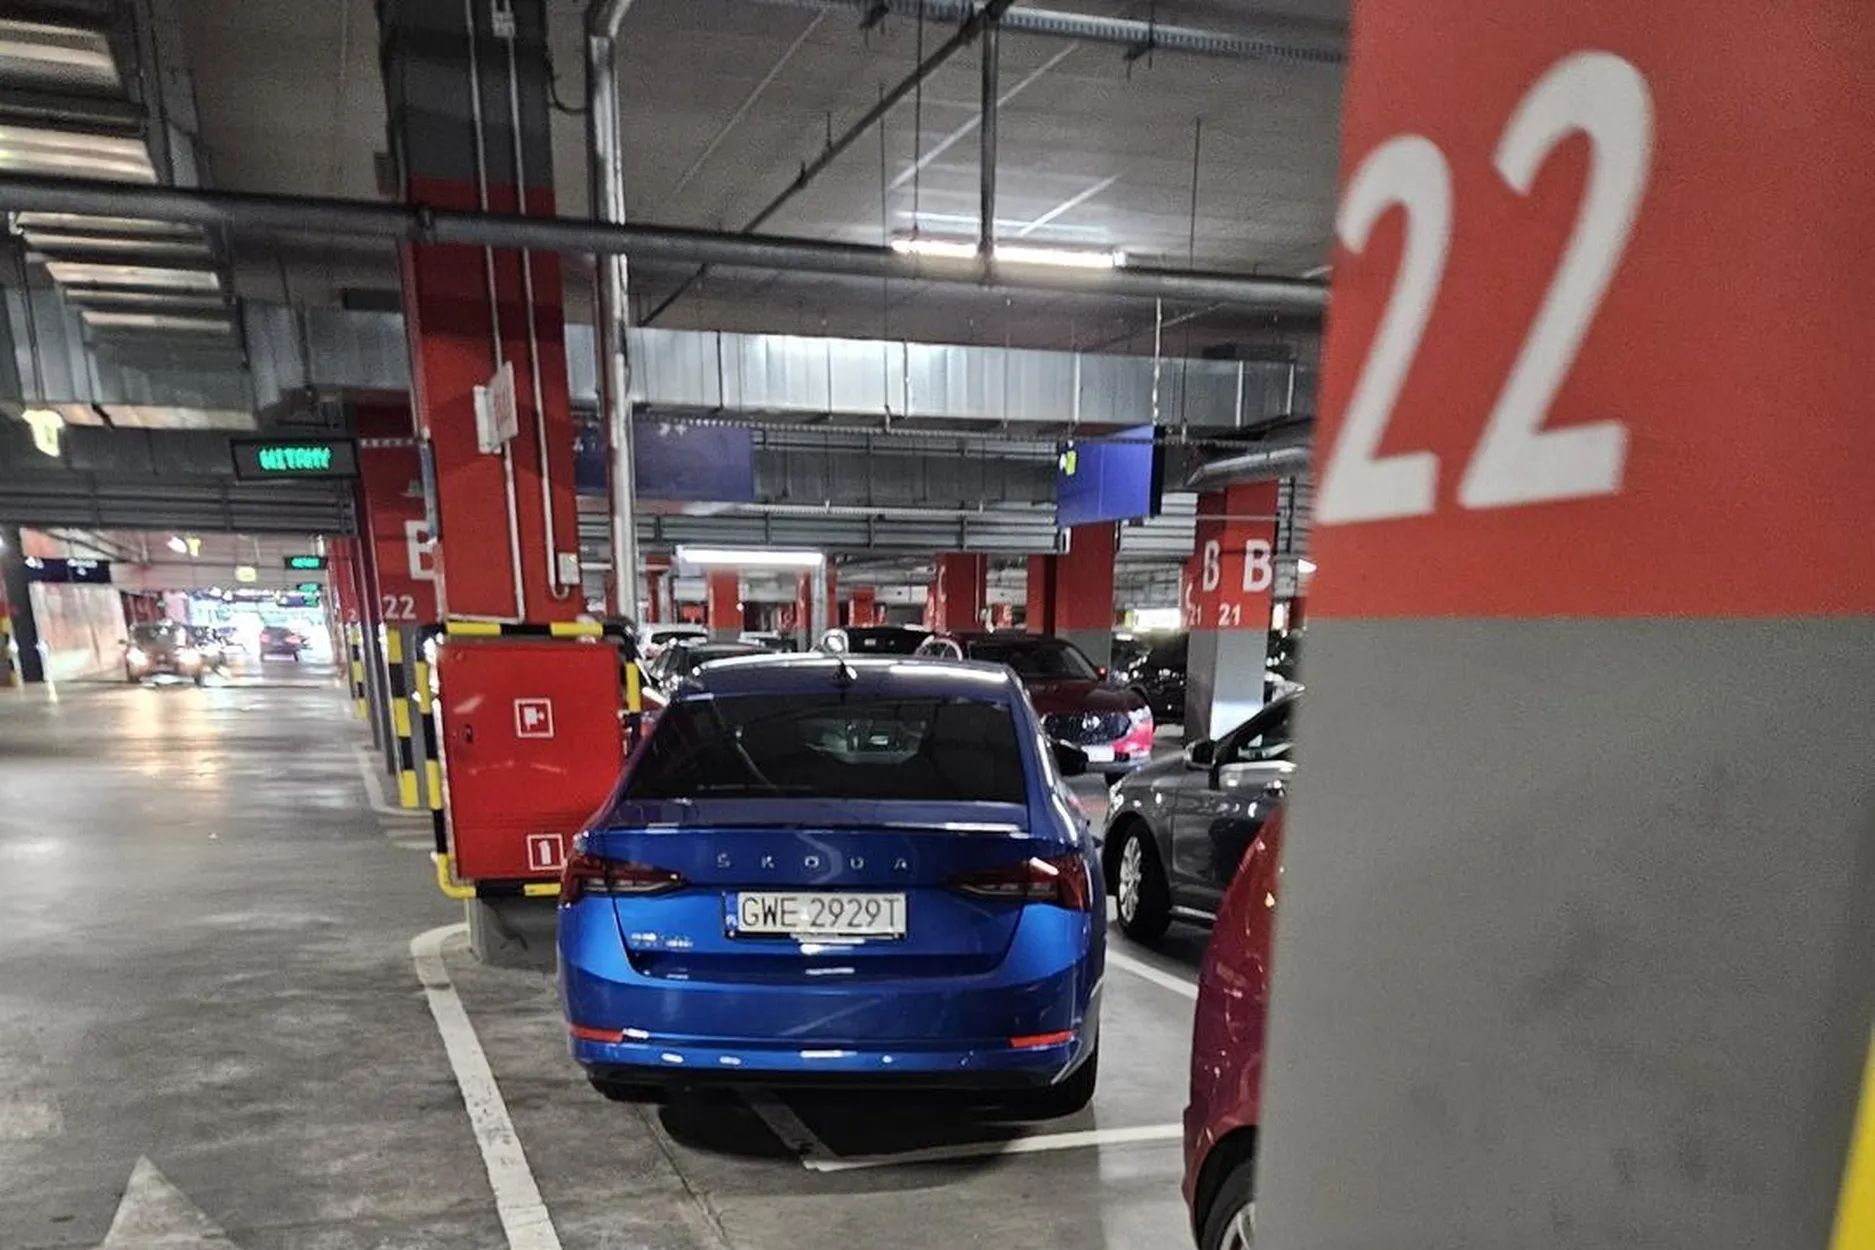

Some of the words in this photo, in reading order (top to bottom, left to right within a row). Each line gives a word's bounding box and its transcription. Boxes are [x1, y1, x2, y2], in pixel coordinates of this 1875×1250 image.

[1315, 49, 1655, 525] 22
[1203, 540, 1220, 592] B
[1243, 539, 1272, 592] B
[382, 594, 417, 619] 22
[1218, 602, 1241, 626] 21
[742, 897, 798, 927] GWE
[810, 898, 900, 927] 2929T
